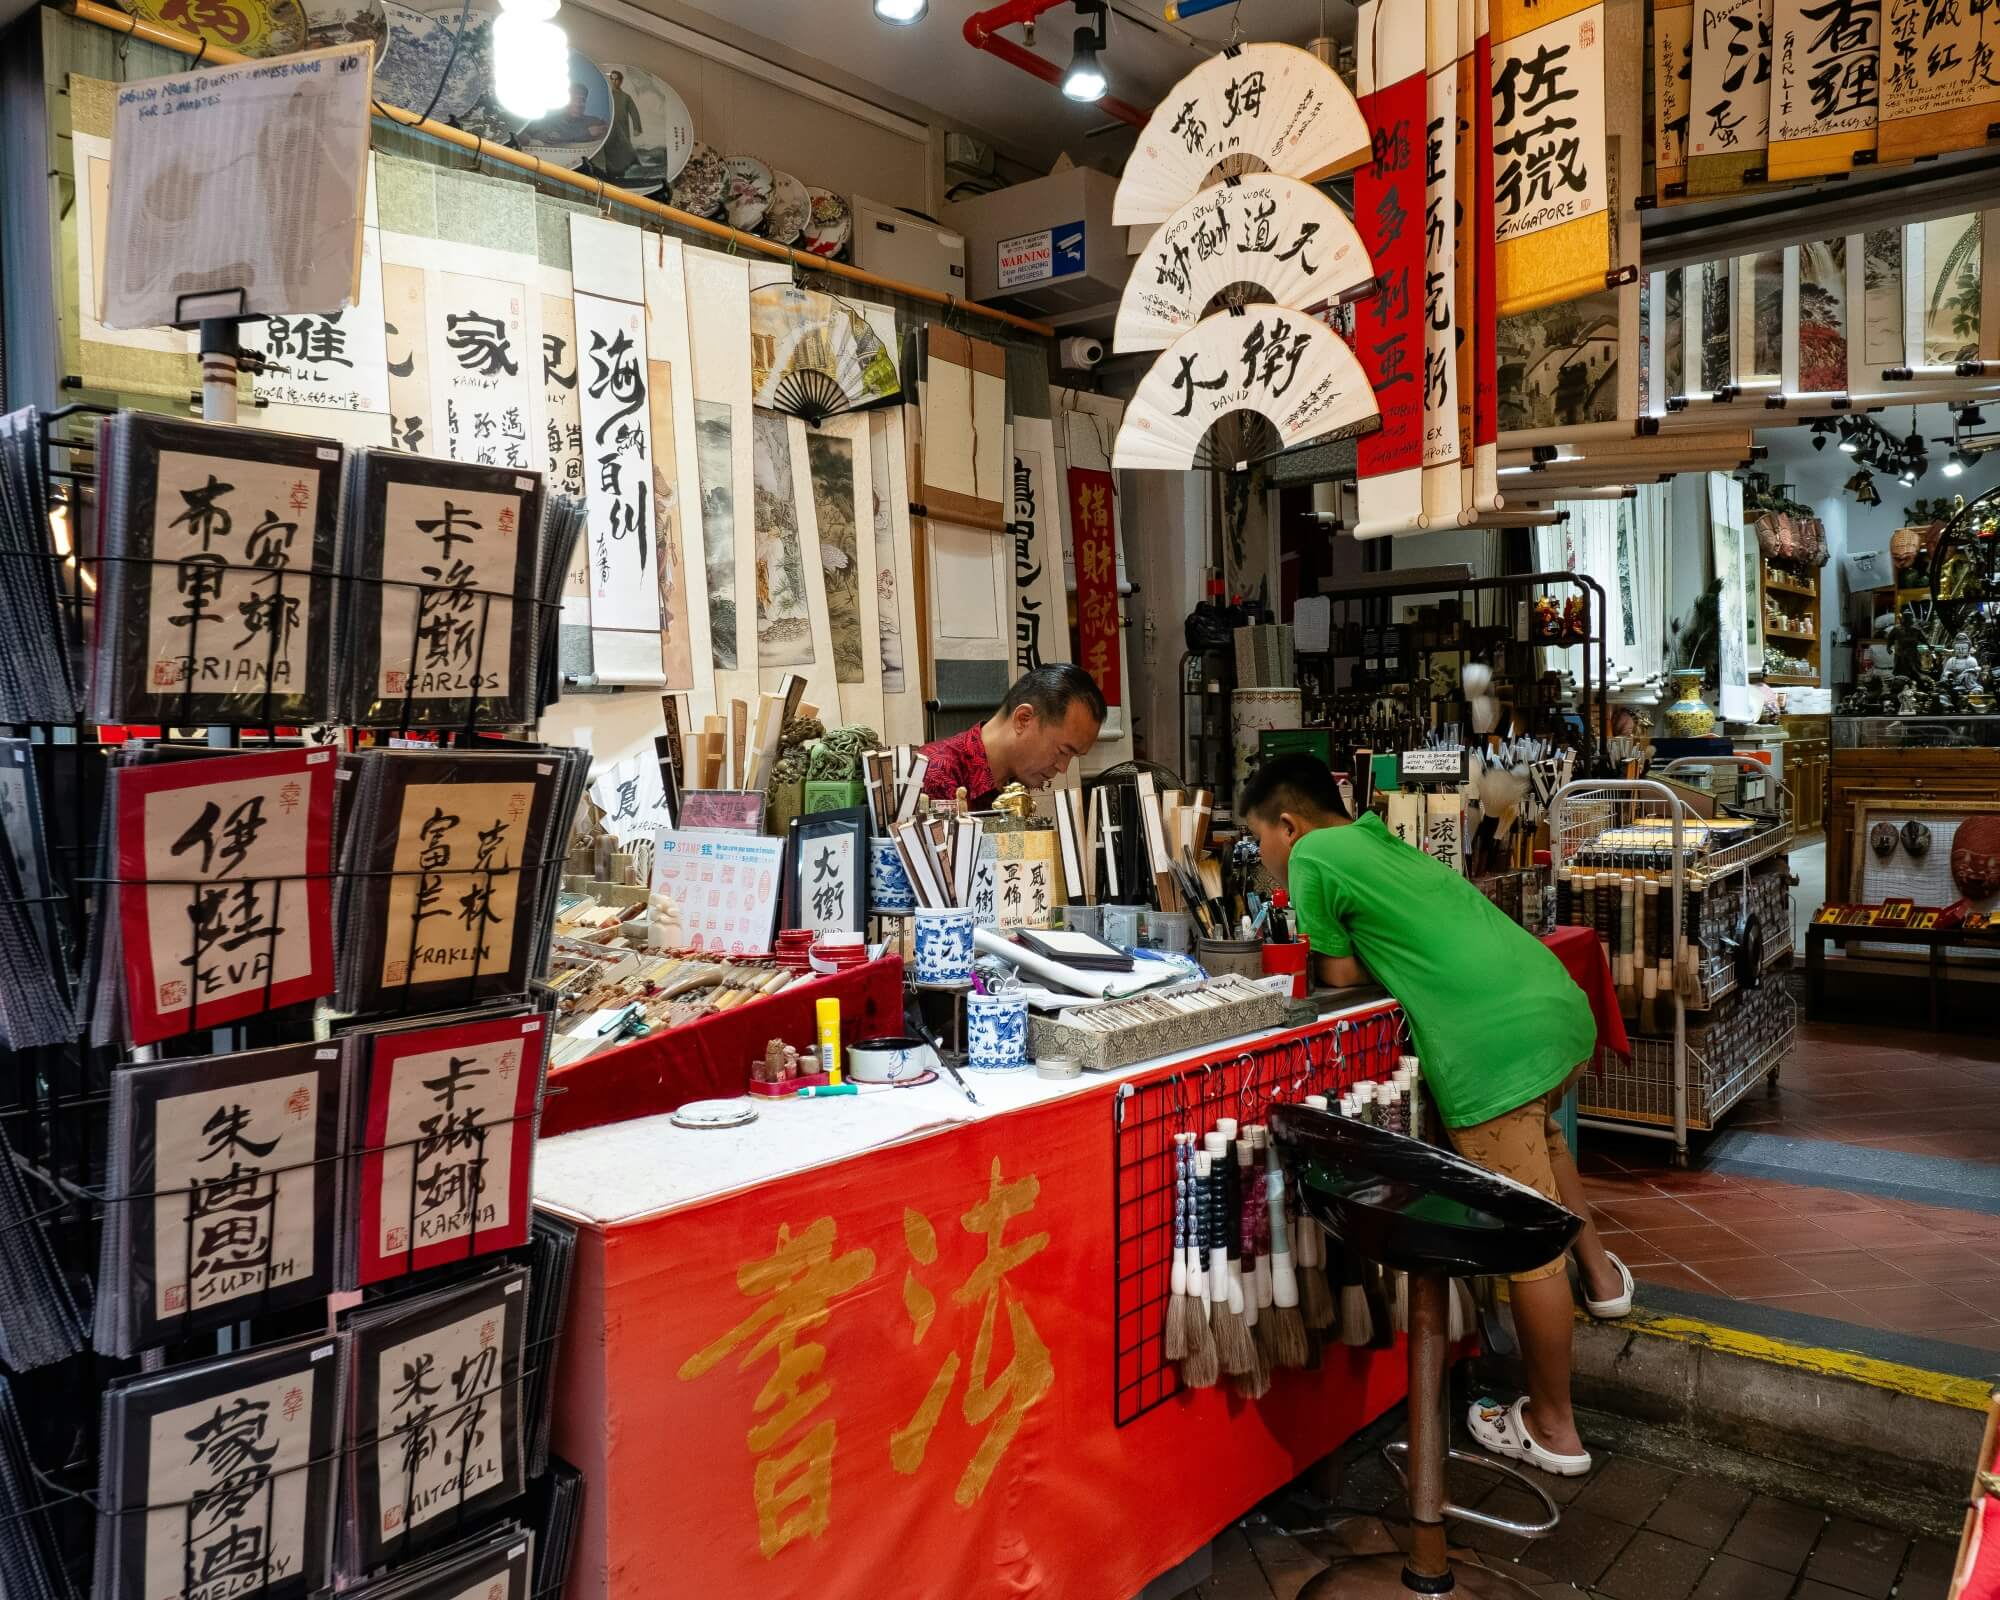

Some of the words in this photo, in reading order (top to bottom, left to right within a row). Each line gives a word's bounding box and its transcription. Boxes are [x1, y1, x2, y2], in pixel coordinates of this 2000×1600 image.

[1206, 135, 1240, 157] TIM
[1243, 187, 1273, 201] WORK
[1495, 201, 1574, 240] SINGAPORE
[1000, 248, 1050, 268] WARNING
[446, 310, 518, 376] 家
[1209, 390, 1250, 411] DAVID
[176, 655, 291, 684] BRIANA
[404, 671, 499, 692] CARLOS
[197, 953, 274, 994] EVA
[197, 1258, 295, 1301] JUDITH
